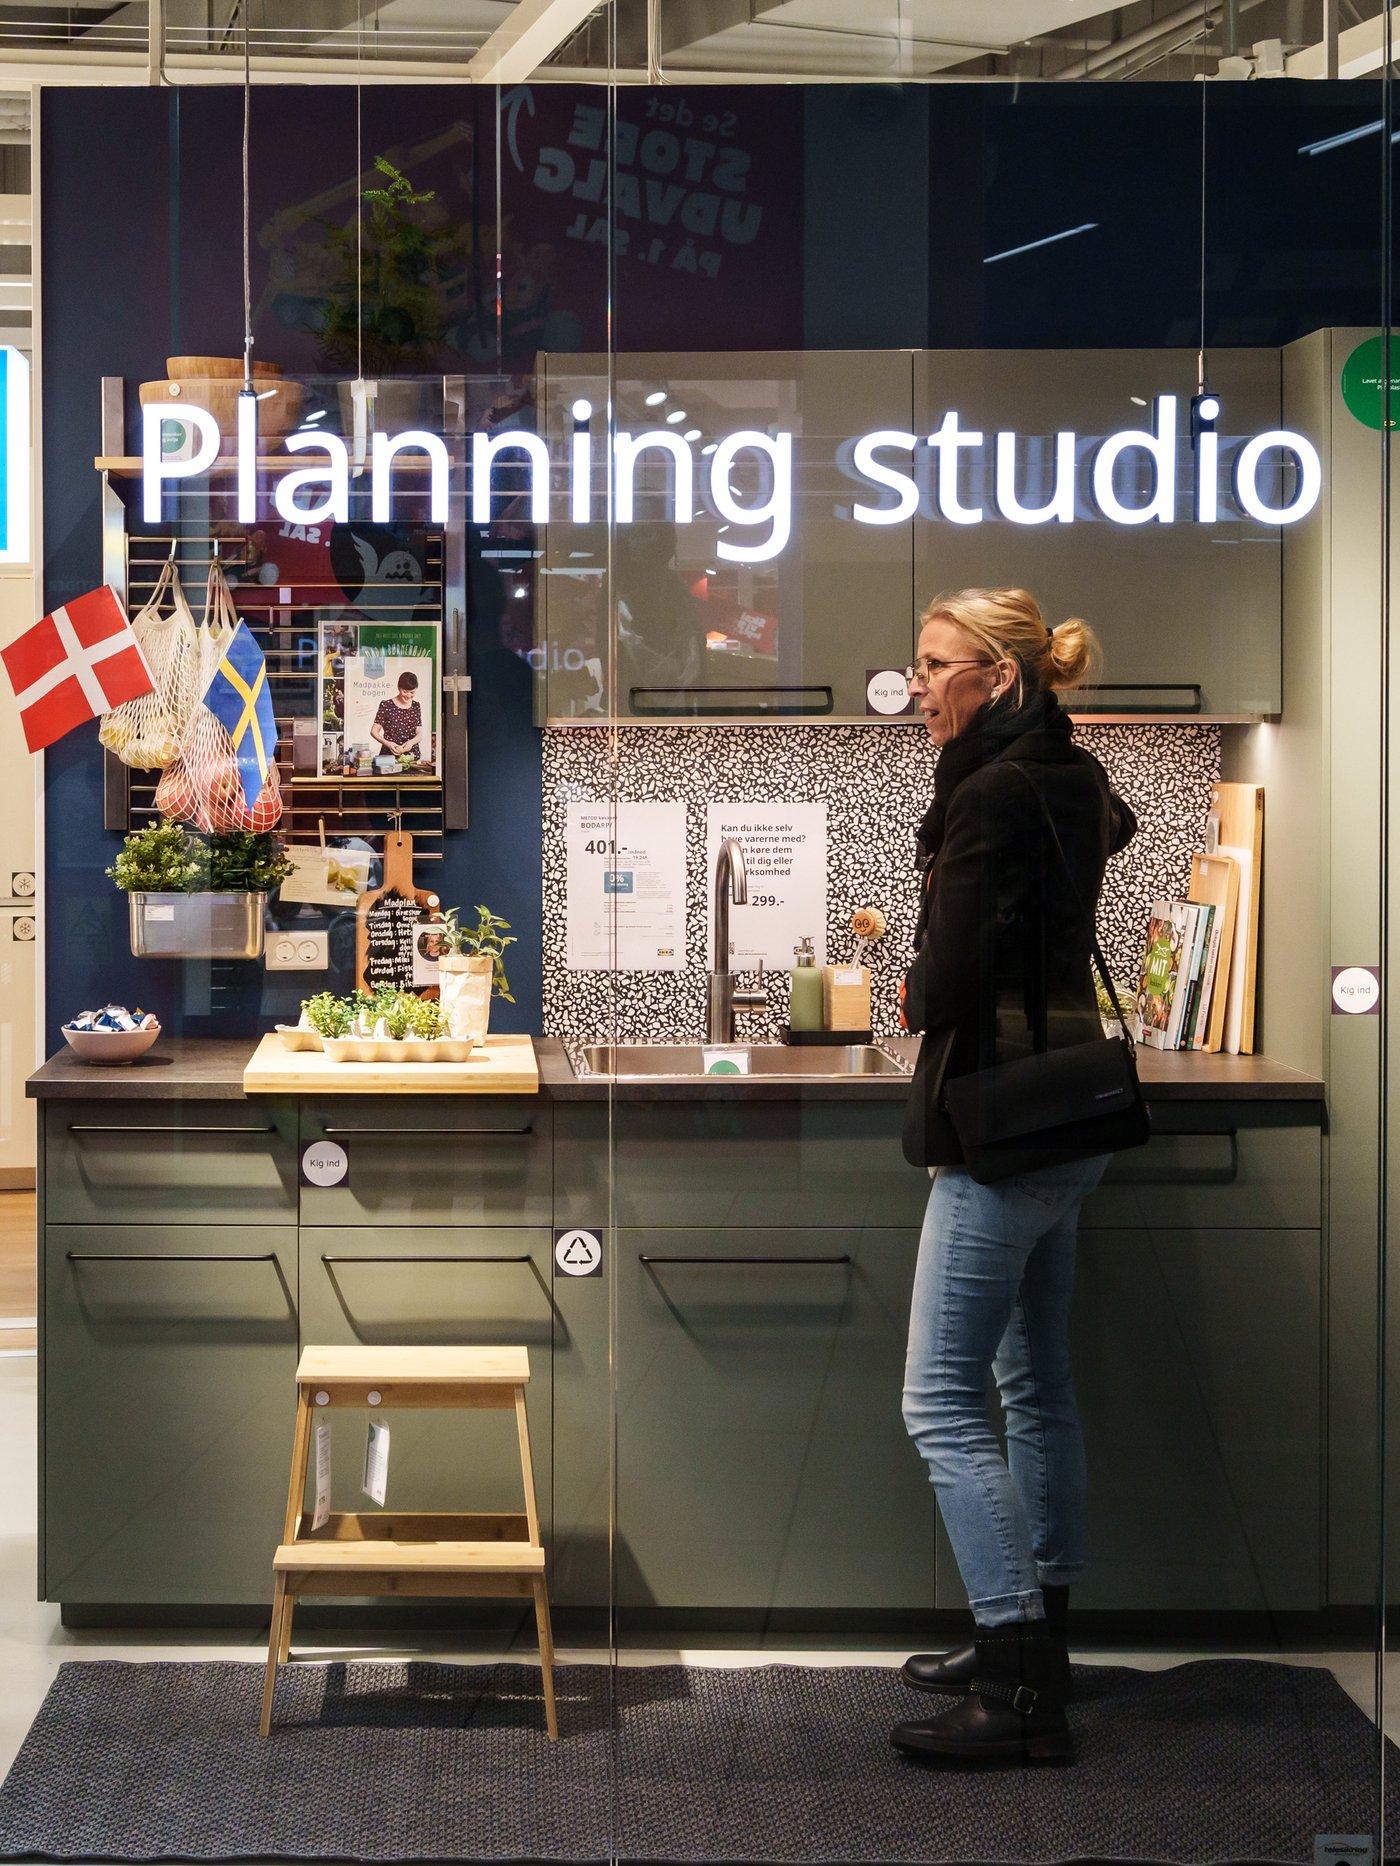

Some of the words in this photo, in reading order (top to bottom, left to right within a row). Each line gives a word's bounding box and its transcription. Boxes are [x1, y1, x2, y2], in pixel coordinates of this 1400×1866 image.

[143, 395, 793, 563] Planning
[852, 395, 1323, 525] studio
[353, 681, 394, 689] Madpakke-
[362, 689, 386, 697] bogen
[874, 688, 889, 698] Kig
[890, 688, 904, 696] ind
[721, 824, 739, 832] Kan
[740, 824, 752, 832] du
[754, 824, 773, 832] ikke
[775, 824, 793, 832] selv
[781, 835, 806, 843] med?
[585, 839, 628, 855] 401.-
[746, 856, 756, 865] til
[757, 856, 772, 866] dig
[773, 856, 794, 865] eller
[745, 868, 791, 876] rksomhed
[384, 899, 417, 909] Madplan
[751, 895, 785, 907] 299.-
[1150, 956, 1168, 978] MIT
[1340, 986, 1355, 996] Kig
[1357, 986, 1371, 994] ind
[310, 1159, 324, 1169] Kig
[326, 1159, 340, 1167] ind
